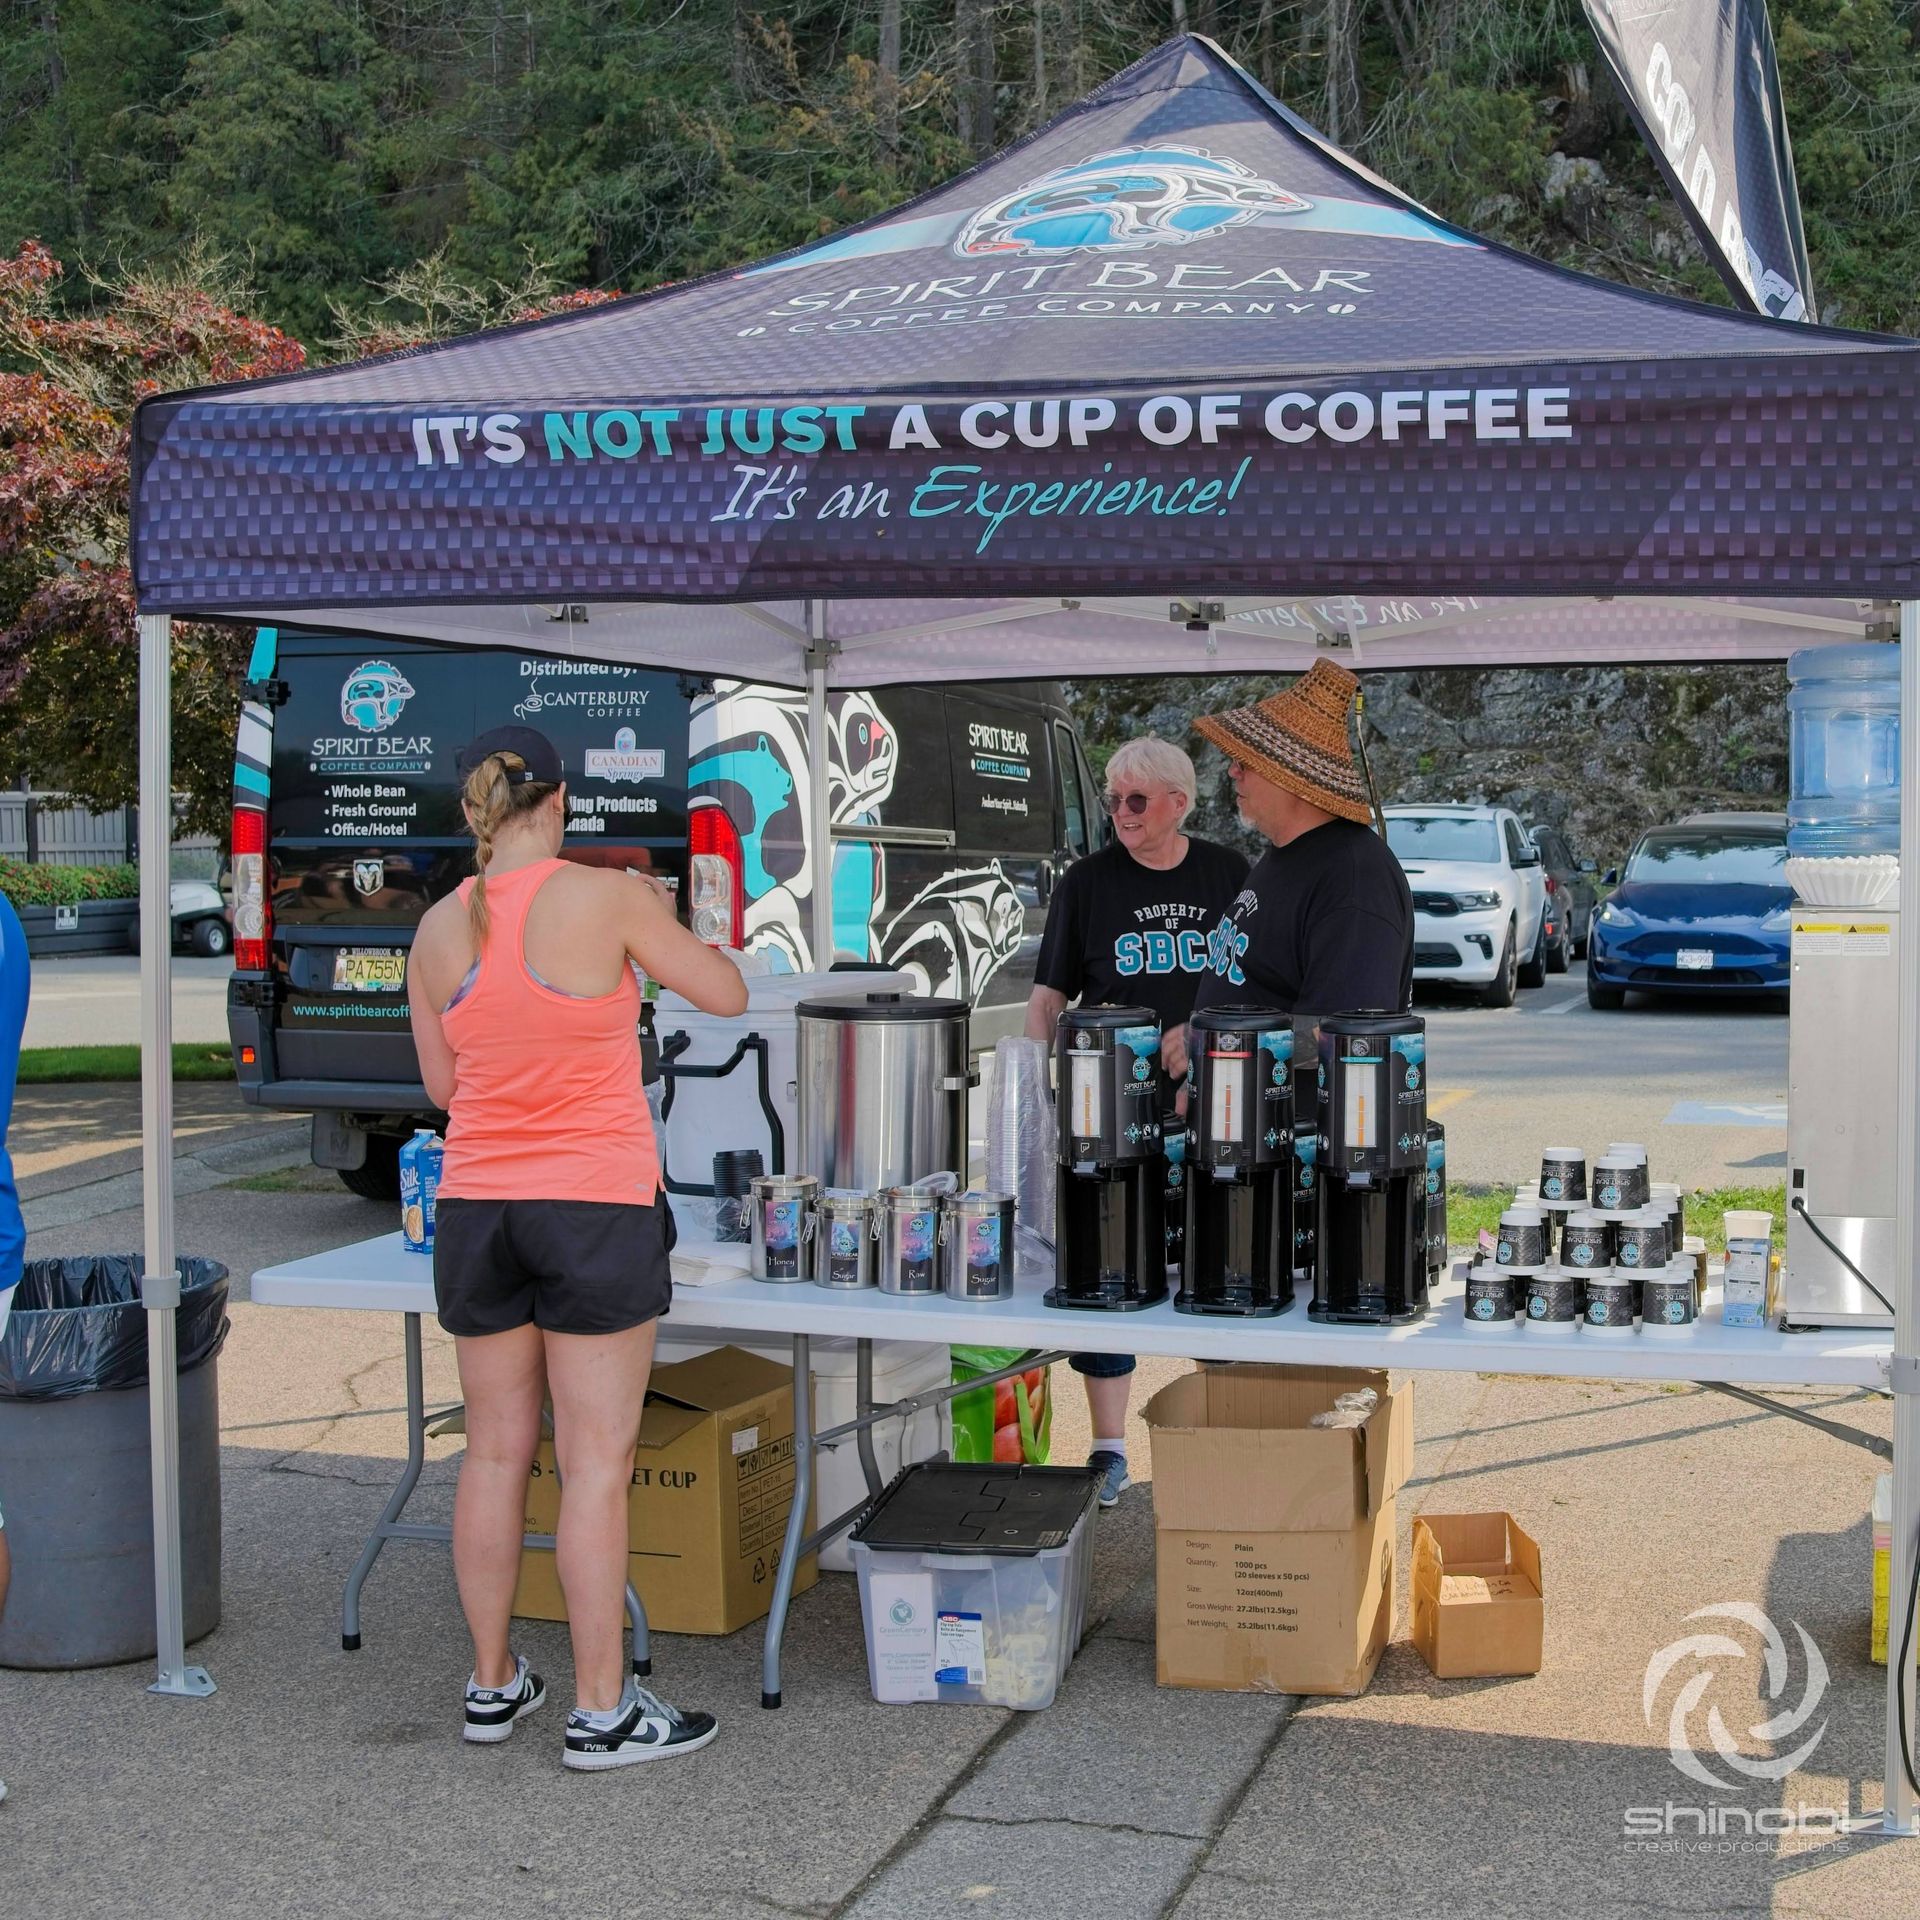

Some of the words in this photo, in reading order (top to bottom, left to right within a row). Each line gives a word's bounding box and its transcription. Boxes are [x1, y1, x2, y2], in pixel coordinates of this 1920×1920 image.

[767, 262, 1077, 317] SPIRIT
[1083, 260, 1375, 295] BEAR
[788, 304, 1008, 336] COFFEE
[1036, 300, 1320, 315] COMPANY
[412, 413, 526, 465] IT'S
[543, 410, 680, 461] NOT
[700, 405, 867, 456] JUST
[888, 404, 942, 449] A
[959, 400, 1124, 450] CUP
[1138, 395, 1242, 446] OF
[1264, 387, 1573, 444] COFFEE
[710, 464, 810, 523] It's
[817, 484, 892, 521] an
[909, 456, 1253, 555] Experience!
[520, 660, 609, 677] Distributed
[543, 690, 650, 706] CANTERBURY
[587, 707, 641, 718] COFFEE
[968, 722, 999, 751] SPIRIT
[1001, 728, 1030, 756] BEAR
[311, 738, 374, 756] SPIRIT
[376, 736, 433, 755] BEAR
[320, 762, 365, 771] COFFEE
[370, 761, 424, 771] COMPANY
[592, 754, 658, 767] CANADIAN
[976, 759, 1000, 773] COFFEE
[1001, 762, 1027, 778] COMPANY
[606, 769, 644, 782] Springs
[331, 784, 372, 798] Whole
[374, 784, 406, 797] Bean
[332, 803, 366, 817] Fresh
[368, 803, 417, 817] Ground
[596, 796, 658, 813] Products
[332, 822, 408, 837] Office/Hotel
[1133, 903, 1208, 922] PROPERTY
[1165, 917, 1179, 930] OF
[400, 1166, 421, 1191] Silk
[768, 1256, 795, 1267] Honey
[832, 1271, 855, 1281] Sugar
[908, 1269, 925, 1279] Raw
[971, 1274, 996, 1285] Sugar
[631, 1468, 653, 1486] ET
[659, 1470, 697, 1489] CUP
[764, 1511, 776, 1523] PET
[1185, 1540, 1212, 1549] Design:
[1234, 1543, 1254, 1552] Plain
[1185, 1557, 1218, 1567] Quantity:
[1235, 1561, 1254, 1569] 1000
[1254, 1562, 1268, 1571] pcs
[1234, 1571, 1247, 1580] (20
[1248, 1571, 1277, 1580] sleeves
[1293, 1573, 1310, 1581] pcs)
[1186, 1585, 1202, 1593] Size:
[1236, 1588, 1283, 1598] 12oz(400ml)
[1187, 1602, 1206, 1611] Gross
[1206, 1603, 1234, 1613] Weight:
[1236, 1605, 1298, 1615] 27.2lbs(12.5kgs)
[1187, 1619, 1200, 1627] Net
[1200, 1620, 1228, 1629] Weight:
[474, 1692, 495, 1701] NIKE
[583, 1743, 609, 1752] FVBK
